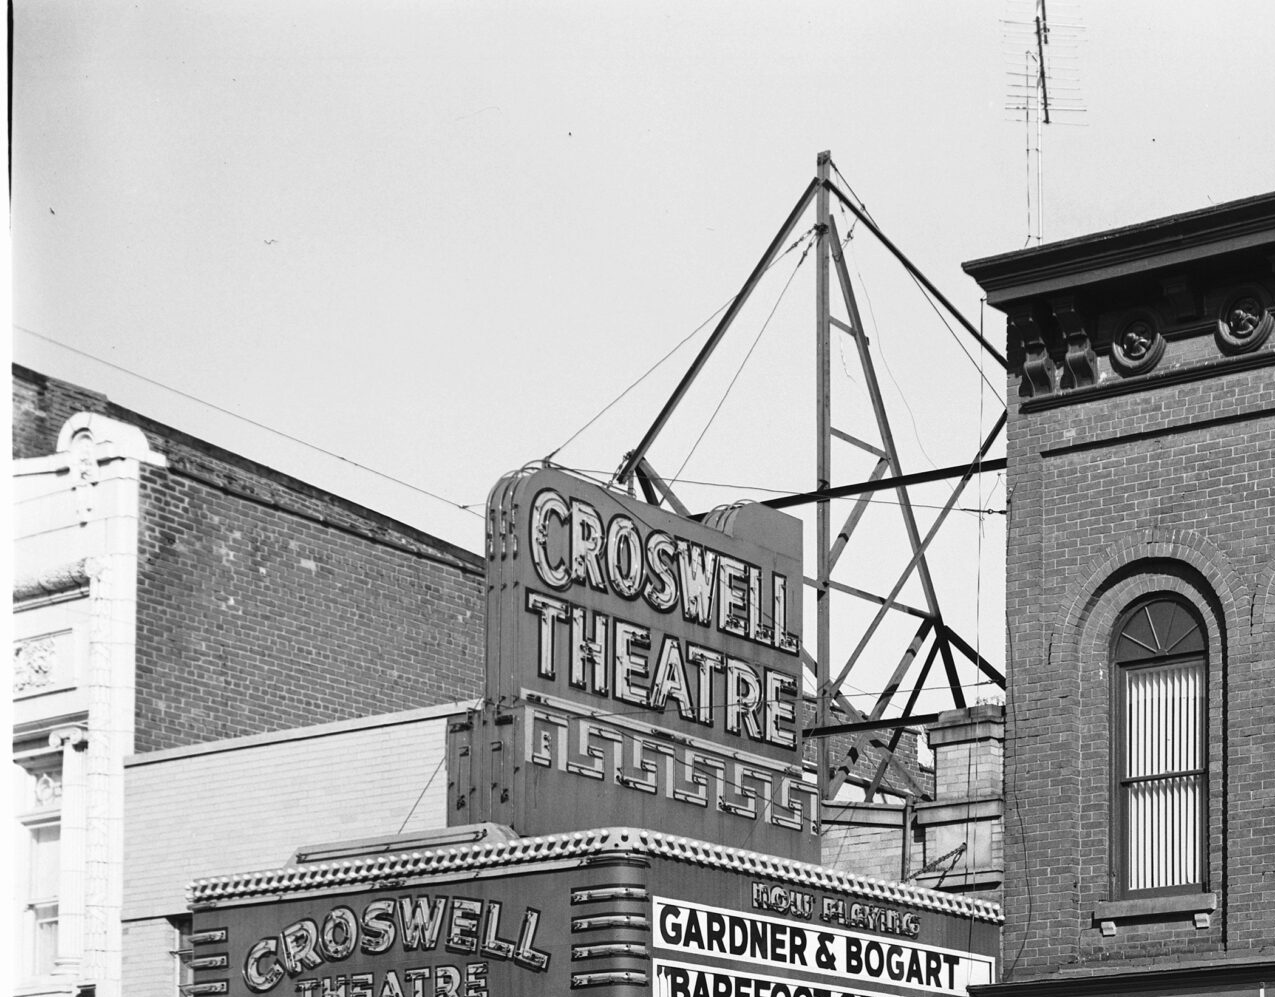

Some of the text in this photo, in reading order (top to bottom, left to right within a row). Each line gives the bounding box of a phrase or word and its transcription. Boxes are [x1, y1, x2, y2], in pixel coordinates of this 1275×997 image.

[529, 487, 799, 657] CROSWELL
[525, 587, 797, 751] THEATRE
[242, 894, 551, 993] CROSWELL
[659, 903, 960, 990] GARDNER & BOGART
